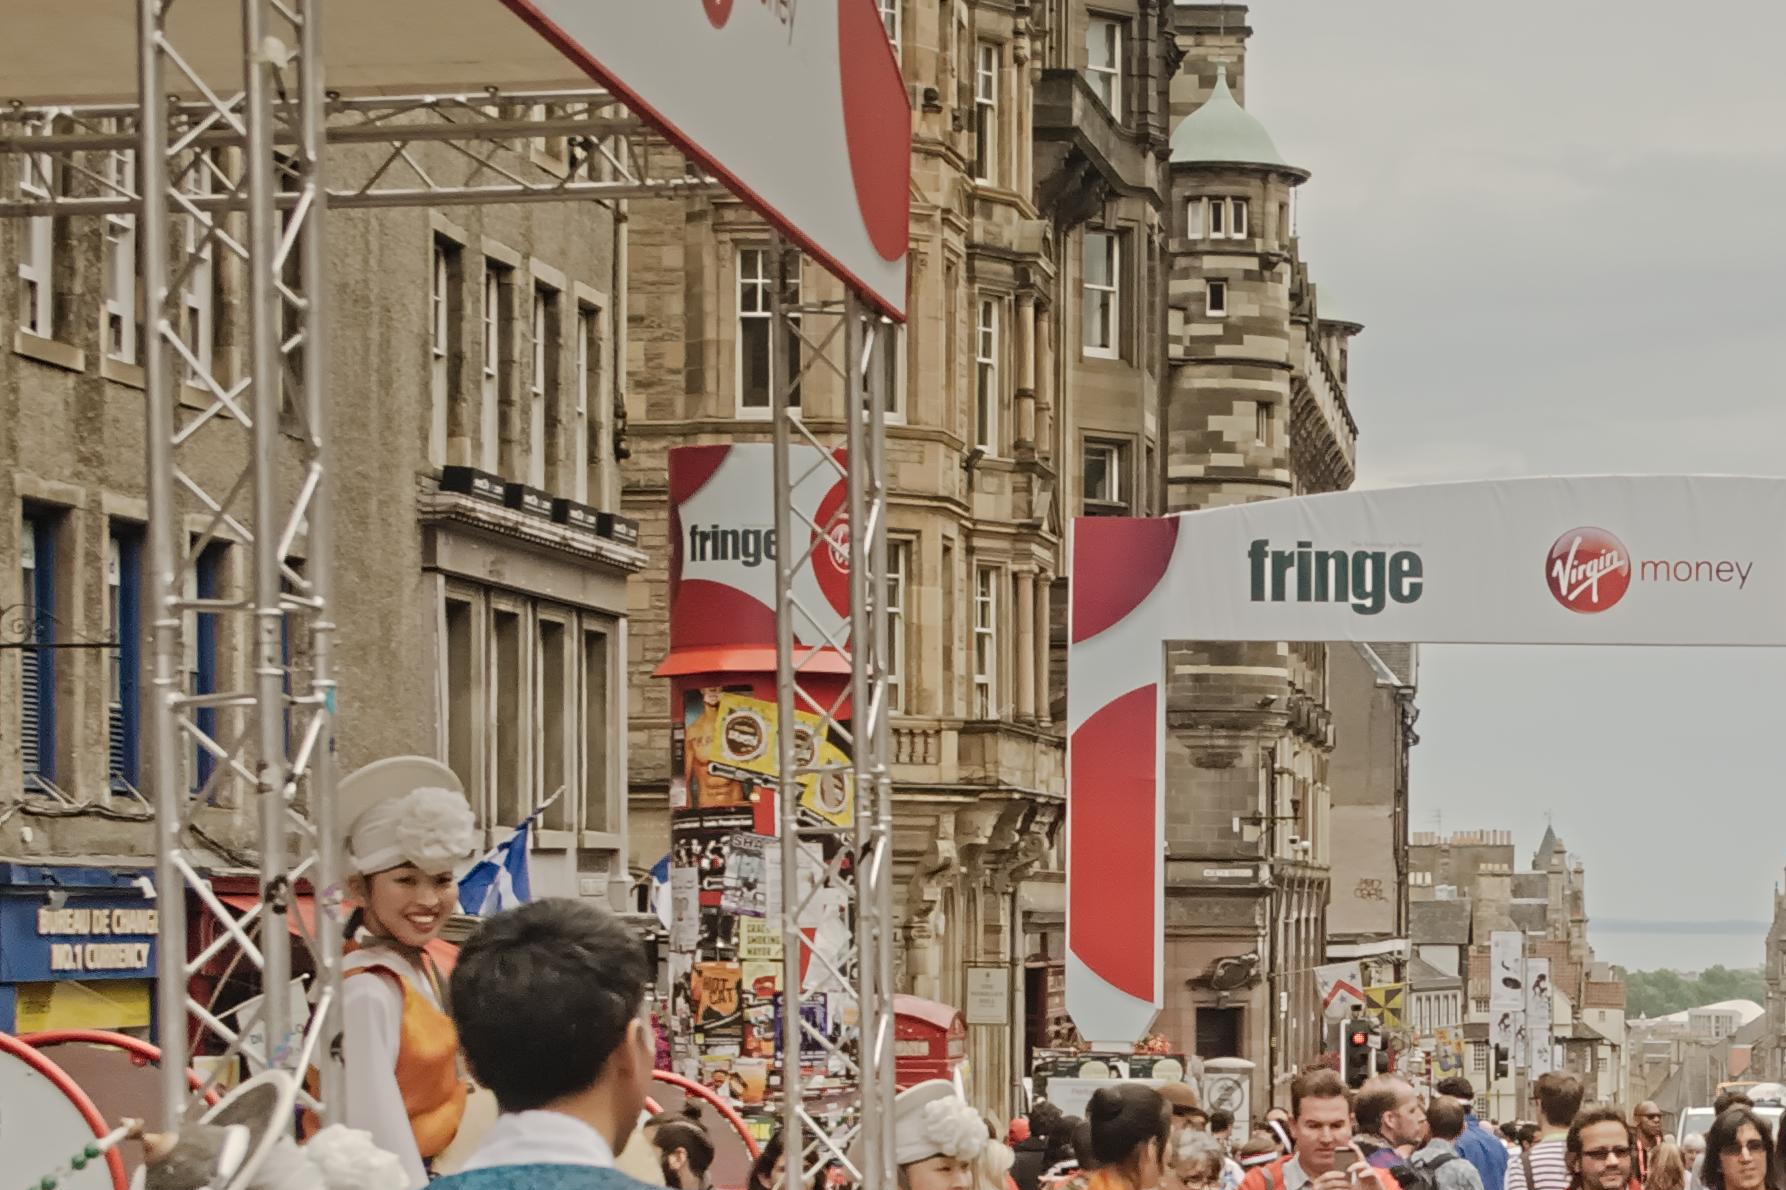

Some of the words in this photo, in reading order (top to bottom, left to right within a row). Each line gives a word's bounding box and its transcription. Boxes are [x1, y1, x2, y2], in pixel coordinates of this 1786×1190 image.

[1248, 539, 1423, 615] fringe
[1552, 536, 1625, 603] Virgin
[1640, 560, 1753, 590] money
[38, 908, 90, 935] BUREAU
[91, 908, 110, 935] DE
[747, 936, 781, 945] SMOKING
[747, 947, 771, 956] MAYOR
[84, 942, 151, 970] CURRENCY
